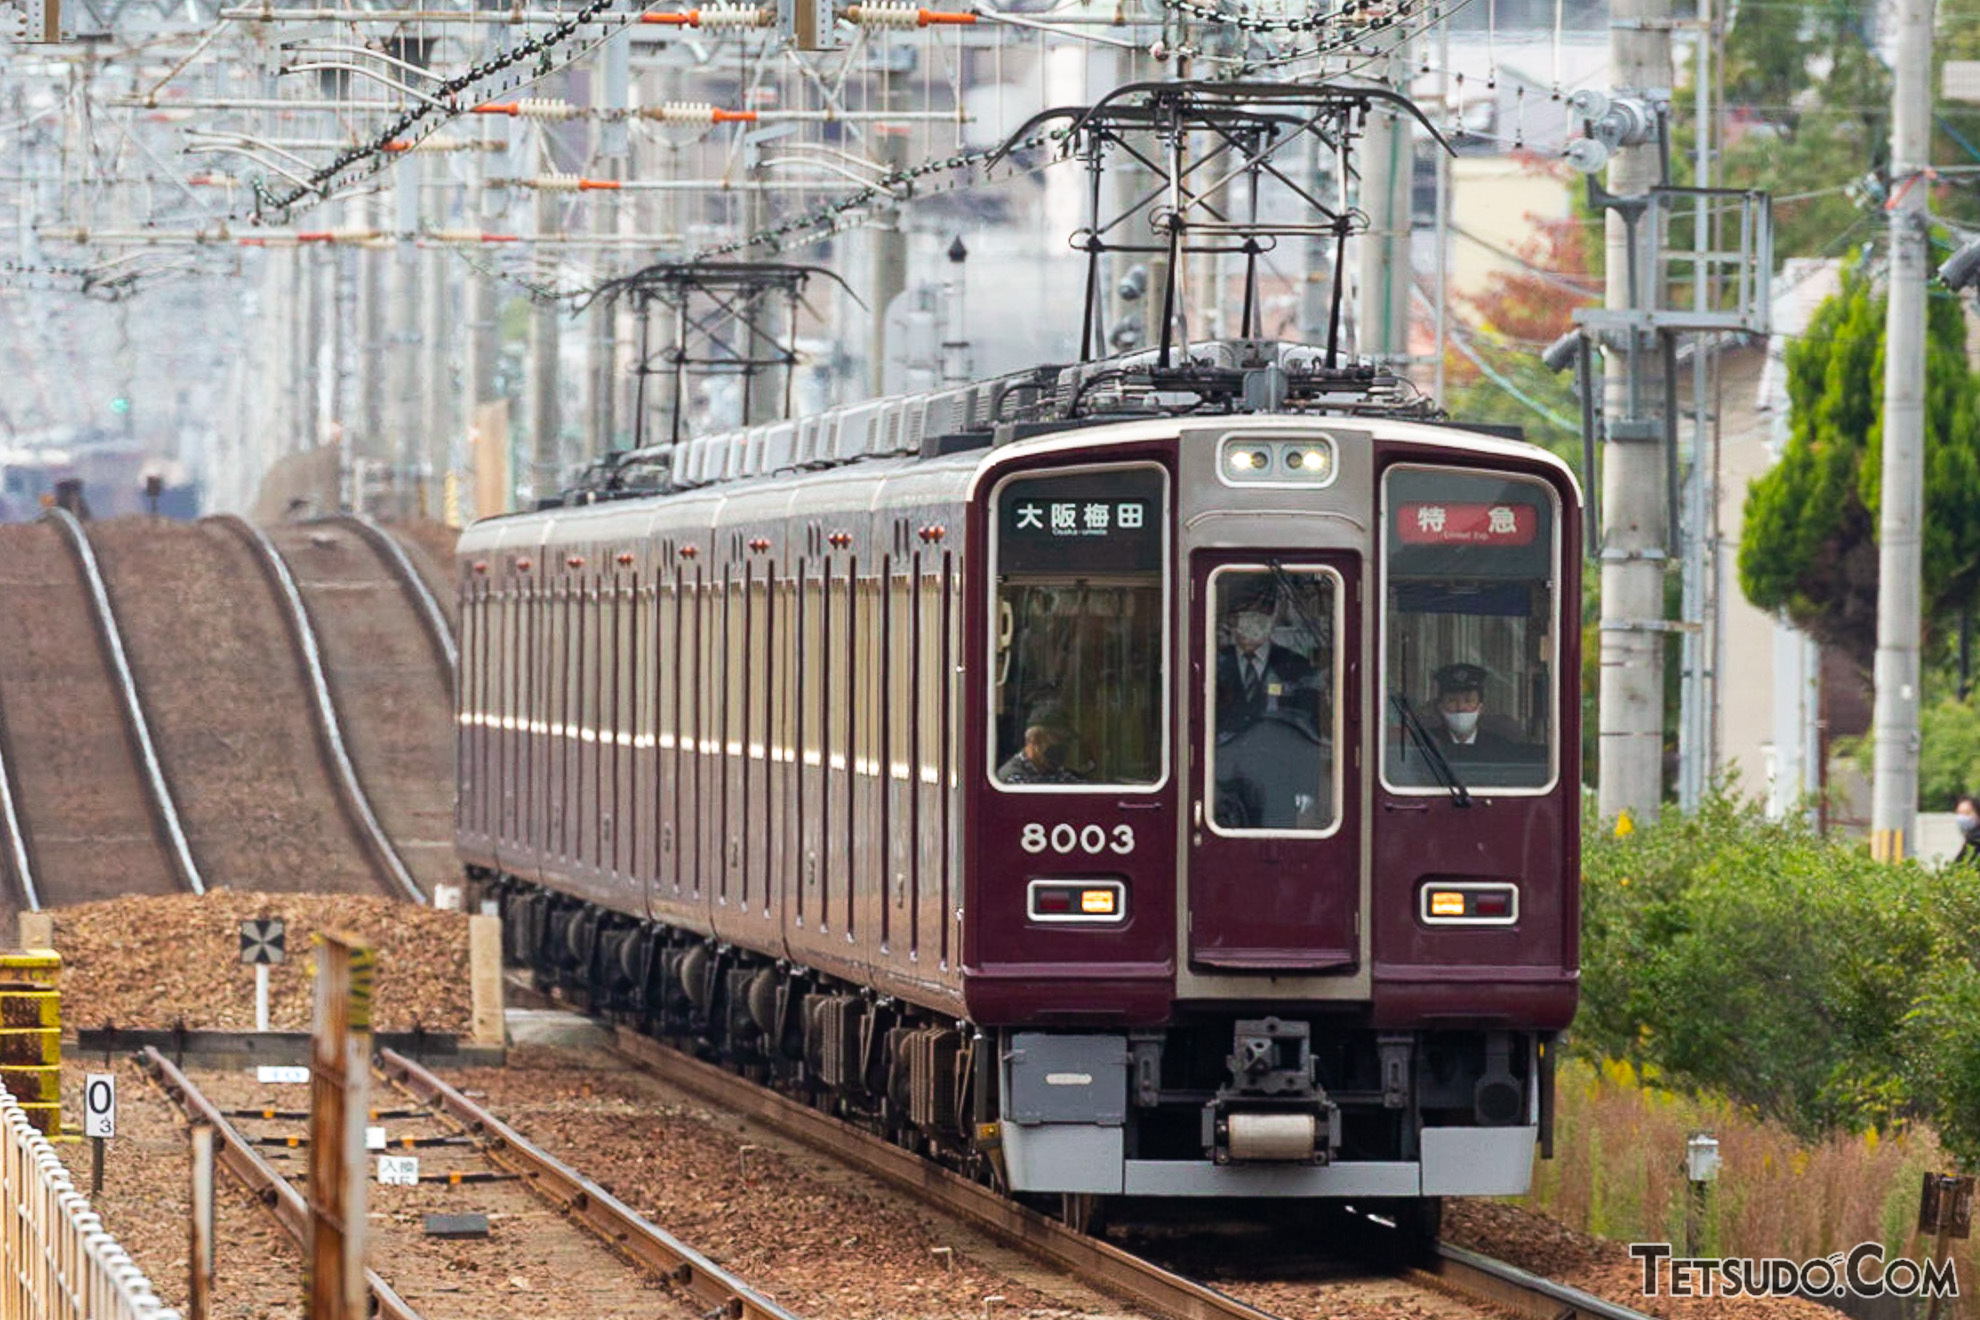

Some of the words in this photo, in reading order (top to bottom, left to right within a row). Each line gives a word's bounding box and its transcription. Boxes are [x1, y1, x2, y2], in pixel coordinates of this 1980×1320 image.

[1016, 503, 1144, 529] 大阪梅田
[1417, 506, 1517, 534] 特急
[1021, 822, 1136, 855] 8003
[89, 1080, 112, 1115] 0
